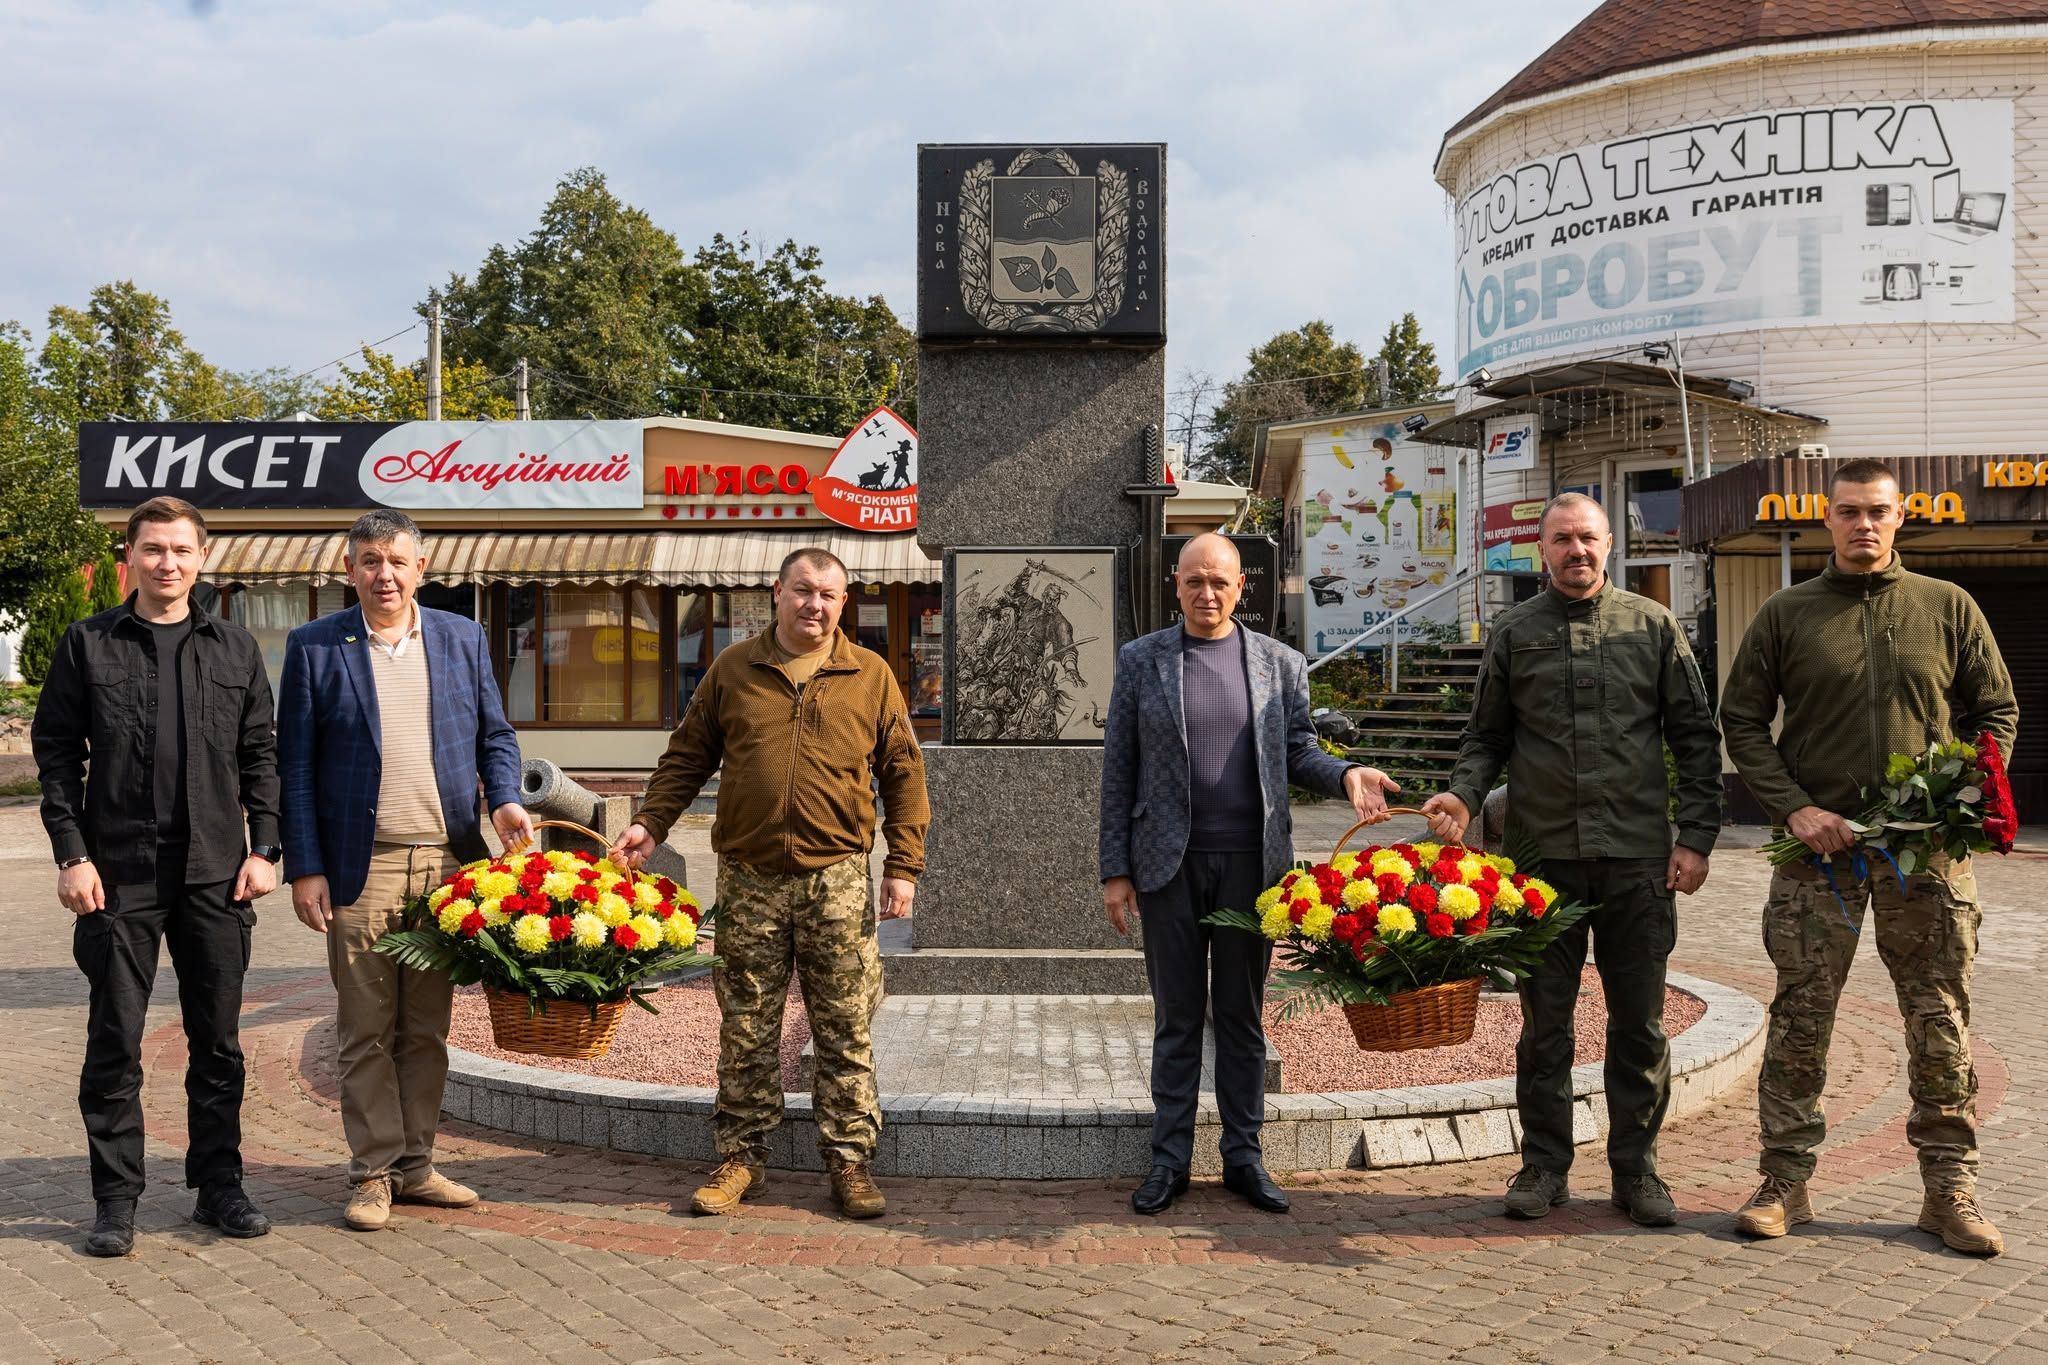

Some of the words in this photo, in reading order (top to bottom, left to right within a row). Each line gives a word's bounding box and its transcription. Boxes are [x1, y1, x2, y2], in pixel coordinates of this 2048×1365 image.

[1602, 104, 1954, 201] ТЕХНІКА
[935, 201, 950, 270] Нова
[1136, 179, 1150, 301] Водолага
[1482, 232, 1535, 267] КРЕДИТ
[1550, 205, 1670, 247] ДОСТАВКА
[1691, 185, 1823, 217] ГАРАНТІЯ
[1492, 344, 1508, 357] ВСЕ
[1510, 338, 1532, 354] ДЛЯ
[1535, 326, 1588, 347] ВАШОГО
[1592, 313, 1674, 336] КОМФОРТУ
[104, 434, 342, 490] КИСЕТ
[373, 439, 633, 491] Акційний
[664, 463, 808, 496] М'ЯСО
[859, 506, 912, 524] РІАЛ
[1421, 561, 1446, 569] МАСЛО
[1336, 627, 1385, 635] ЗАДНО
[1386, 627, 1409, 635] БКУ
